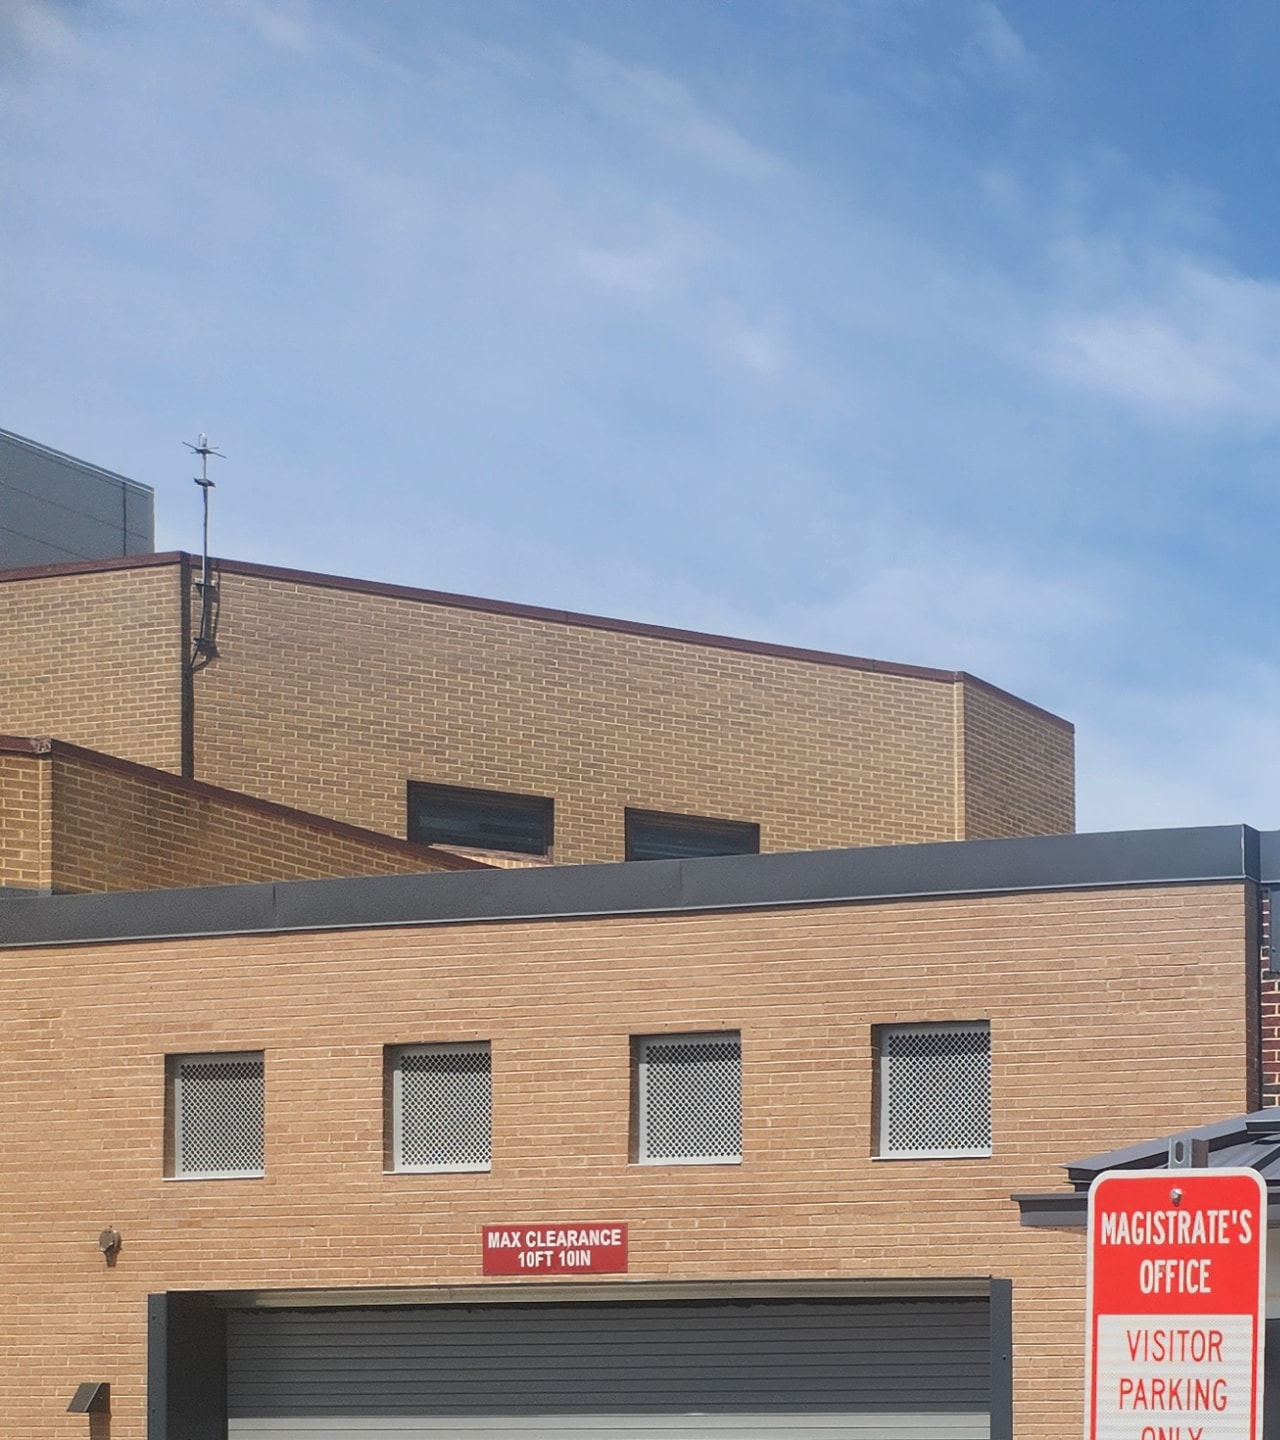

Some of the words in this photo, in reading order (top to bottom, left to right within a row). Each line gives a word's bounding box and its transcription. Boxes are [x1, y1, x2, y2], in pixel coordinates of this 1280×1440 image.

[488, 1231, 522, 1248] MAX
[525, 1229, 622, 1248] CLEARANCE
[1100, 1209, 1253, 1246] MAGISTRATE'S
[518, 1251, 554, 1267] 10FT
[558, 1250, 591, 1266] 10IN
[1139, 1259, 1212, 1294] OFFICE
[1126, 1329, 1224, 1362] VISITOR
[1119, 1378, 1228, 1412] PARKING
